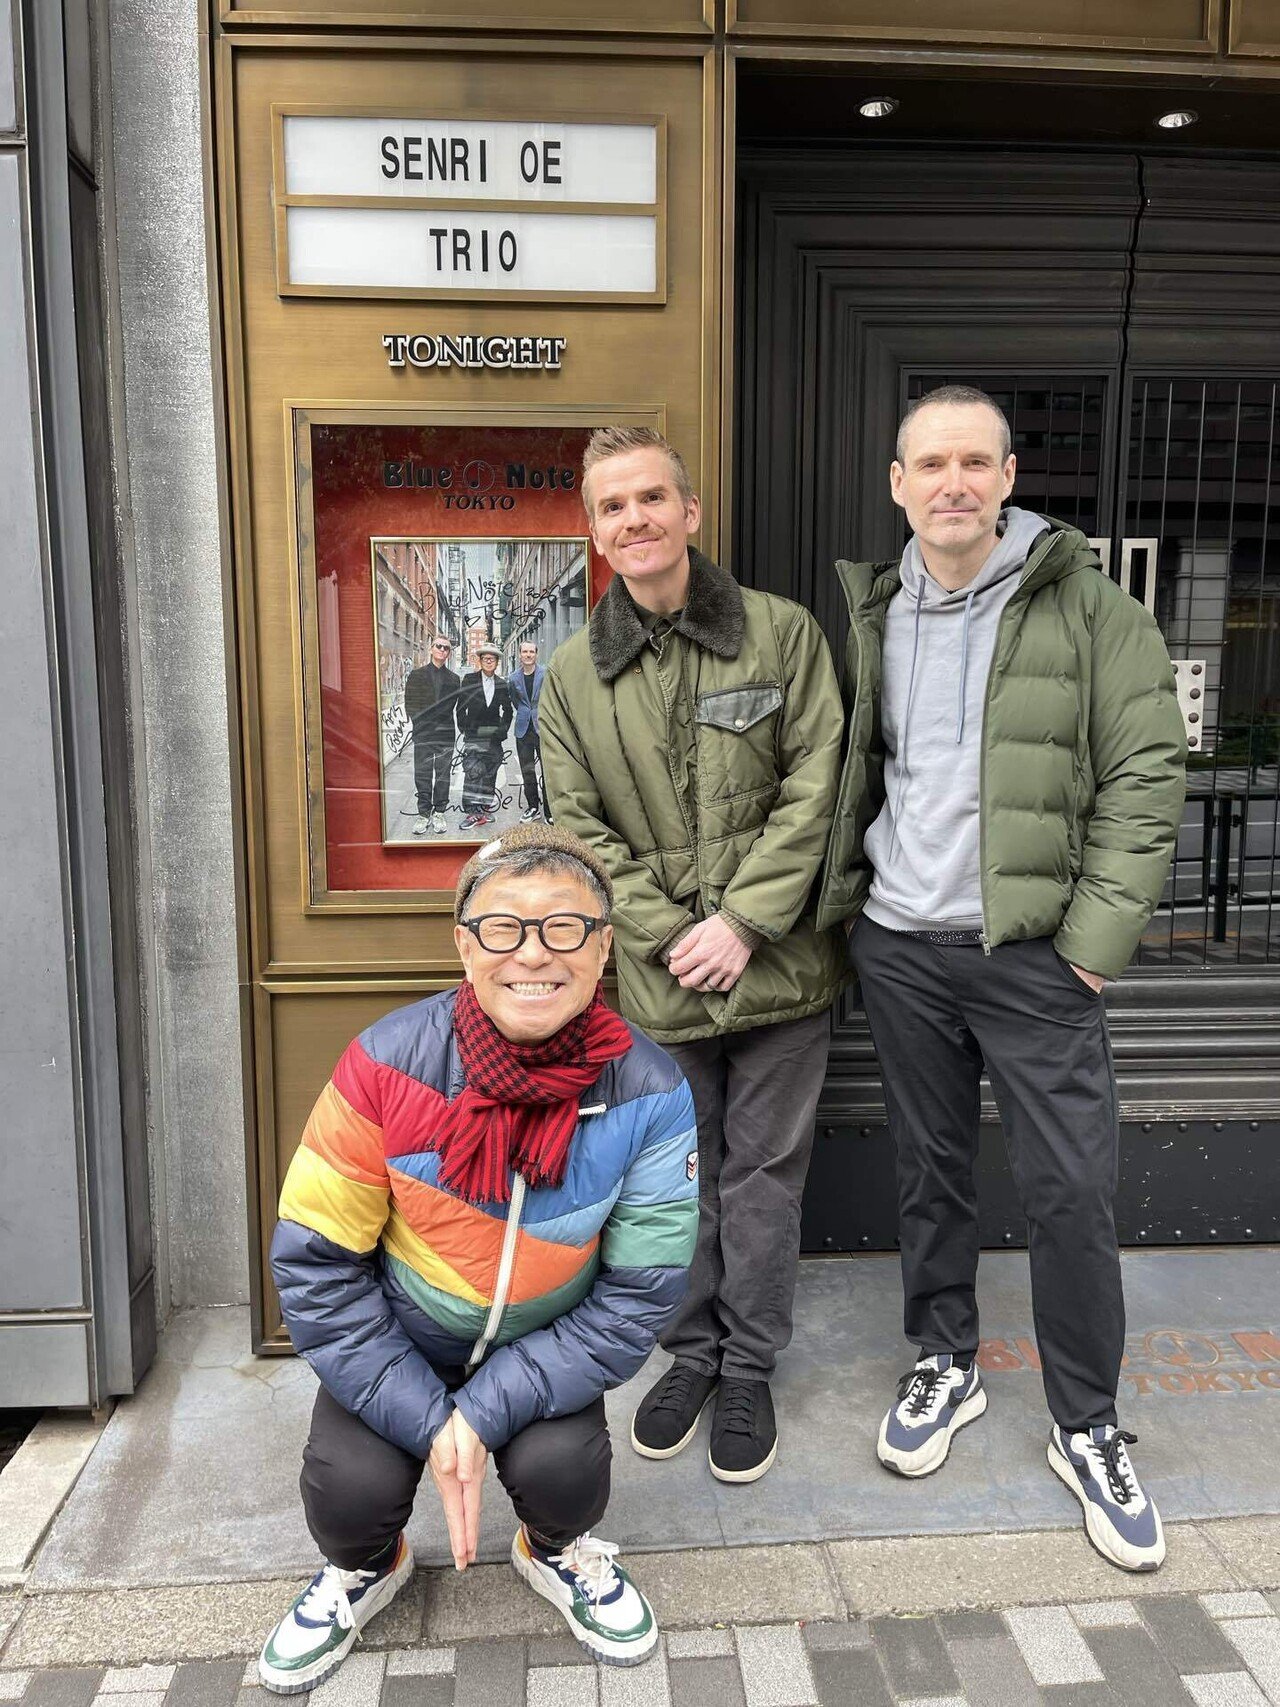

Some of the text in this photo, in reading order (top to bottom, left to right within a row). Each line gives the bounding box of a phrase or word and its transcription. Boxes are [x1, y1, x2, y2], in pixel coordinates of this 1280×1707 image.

[380, 135, 563, 185] SENRI OE
[428, 227, 518, 273] TRIO
[381, 334, 567, 370] TONIGHT
[382, 460, 577, 491] Blue Note
[443, 494, 516, 511] TOKYO
